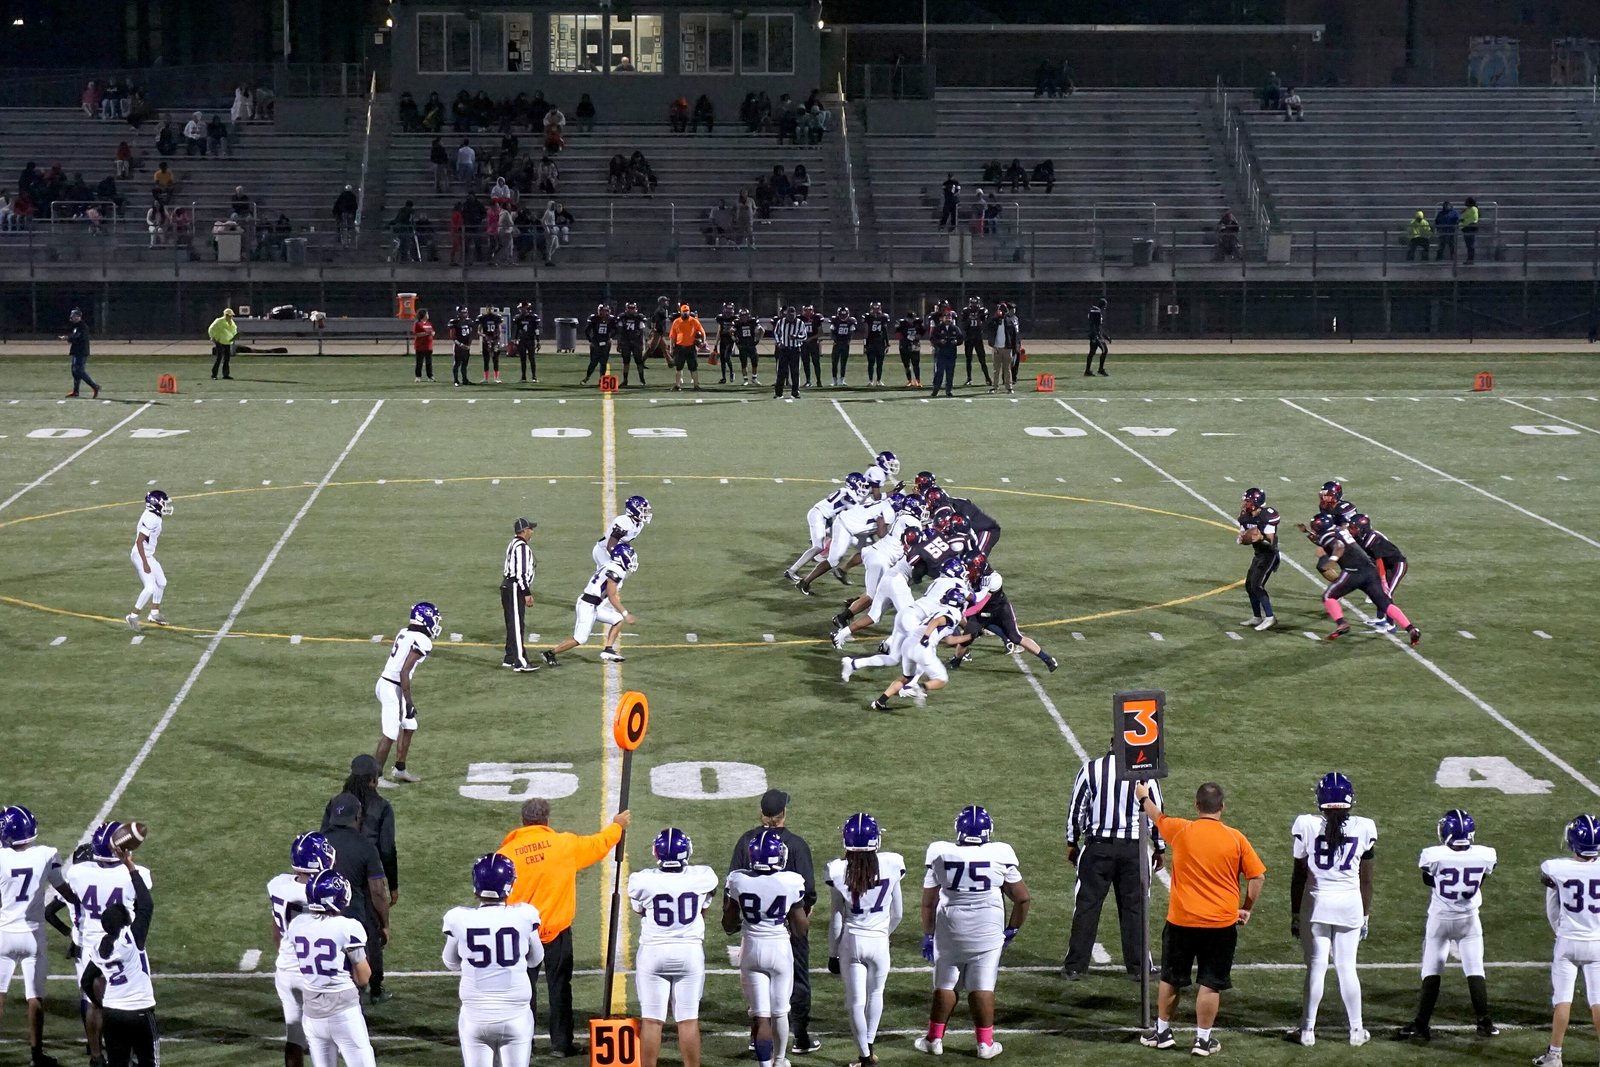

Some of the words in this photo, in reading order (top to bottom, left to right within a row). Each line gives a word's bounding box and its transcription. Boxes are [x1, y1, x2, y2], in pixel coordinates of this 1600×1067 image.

[522, 325, 529, 334] 4
[626, 323, 635, 331] 74
[743, 329, 752, 337] 21
[159, 376, 174, 389] 40
[602, 376, 617, 390] 50
[1479, 376, 1492, 389] 30
[924, 535, 950, 560] 55
[1124, 700, 1158, 746] 3
[514, 840, 552, 856] FOOTBALL
[525, 853, 545, 865] CREW
[1314, 834, 1359, 871] 87
[11, 867, 34, 902] 7
[944, 861, 991, 892] 75
[1439, 867, 1484, 900] 25
[81, 884, 124, 920] 44
[652, 891, 699, 927] 60
[738, 892, 787, 926] 84
[1563, 878, 1600, 914] 35
[294, 936, 338, 977] 22
[466, 926, 521, 968] 50
[104, 960, 129, 987] 2
[594, 1025, 637, 1066] 50
